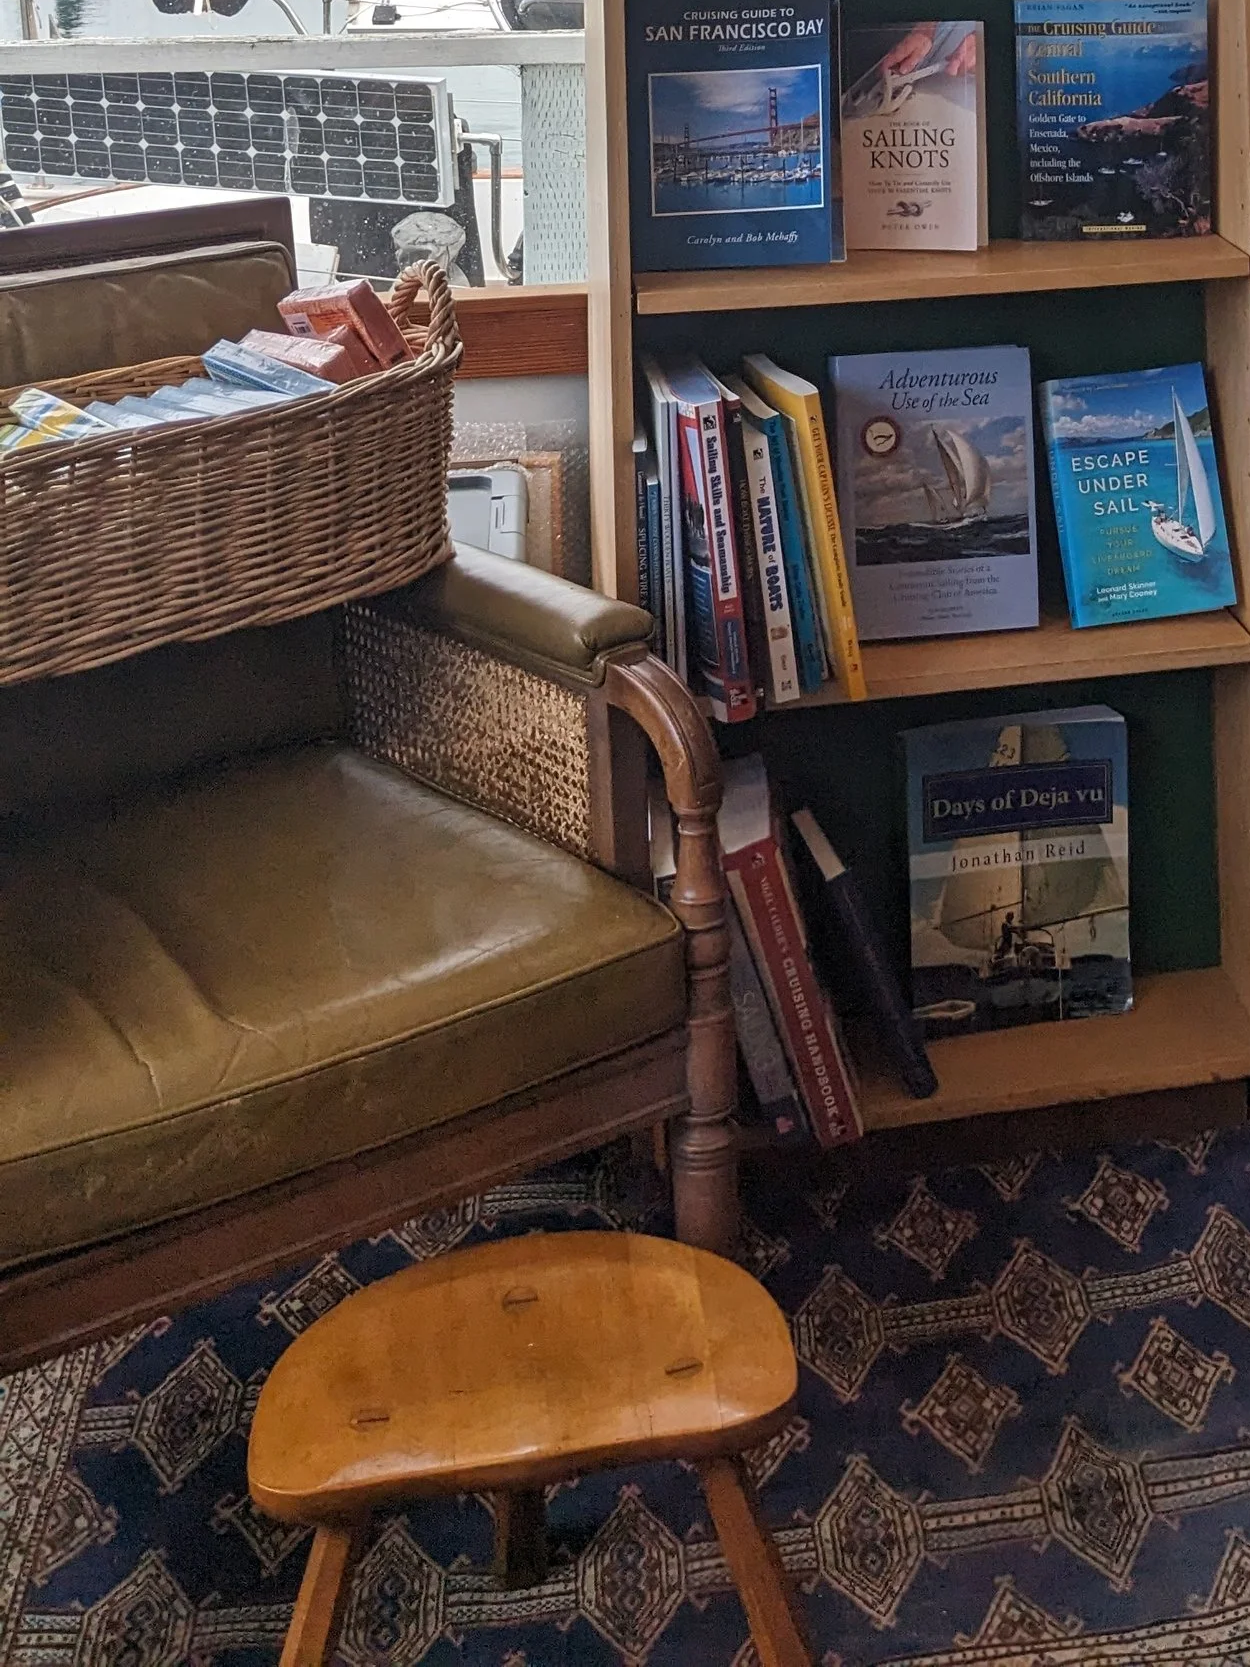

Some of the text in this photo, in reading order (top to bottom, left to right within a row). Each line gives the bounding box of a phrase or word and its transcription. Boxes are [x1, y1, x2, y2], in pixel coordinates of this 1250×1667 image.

[684, 7, 795, 21] CRUISING GUIDE TO
[645, 18, 824, 41] SAN FRANCISCO BAY
[1043, 20, 1106, 38] Cruising
[1111, 18, 1156, 34] Guide
[1028, 68, 1096, 84] Southern
[1029, 89, 1102, 107] California
[1029, 114, 1086, 123] Golden Gate to
[862, 128, 955, 148] SAILING
[1029, 128, 1069, 138] Ensenada,
[1030, 143, 1060, 154] Mexico,
[870, 149, 949, 169] KNOTS
[1030, 158, 1081, 169] including the
[1030, 173, 1094, 183] Offshore Islands
[687, 230, 798, 246] Carolyn and Bob Mehaffy
[879, 368, 998, 390] Adventurous
[891, 388, 990, 412] Use of the Sea
[812, 427, 821, 441] GET
[706, 435, 719, 473] Sailing
[814, 443, 824, 463] YOUR
[1071, 449, 1150, 472] ESCAPE
[710, 476, 722, 505] Skills
[758, 476, 767, 494] The
[1078, 473, 1148, 494] UNDER
[1094, 497, 1139, 516] SAIL
[713, 508, 723, 528] and
[755, 496, 777, 554] NATURE
[824, 504, 836, 531] LICENSE
[715, 531, 730, 594] Seamanship
[764, 565, 784, 612] BOATS
[1096, 581, 1156, 594] Leonard Skinner
[1129, 589, 1157, 598] Cooney
[932, 787, 1104, 820] Days of Deja vu
[951, 840, 1086, 872] Jonathan Reid
[782, 957, 814, 1031] CRUISING
[805, 1032, 841, 1119] HANDBOOK
